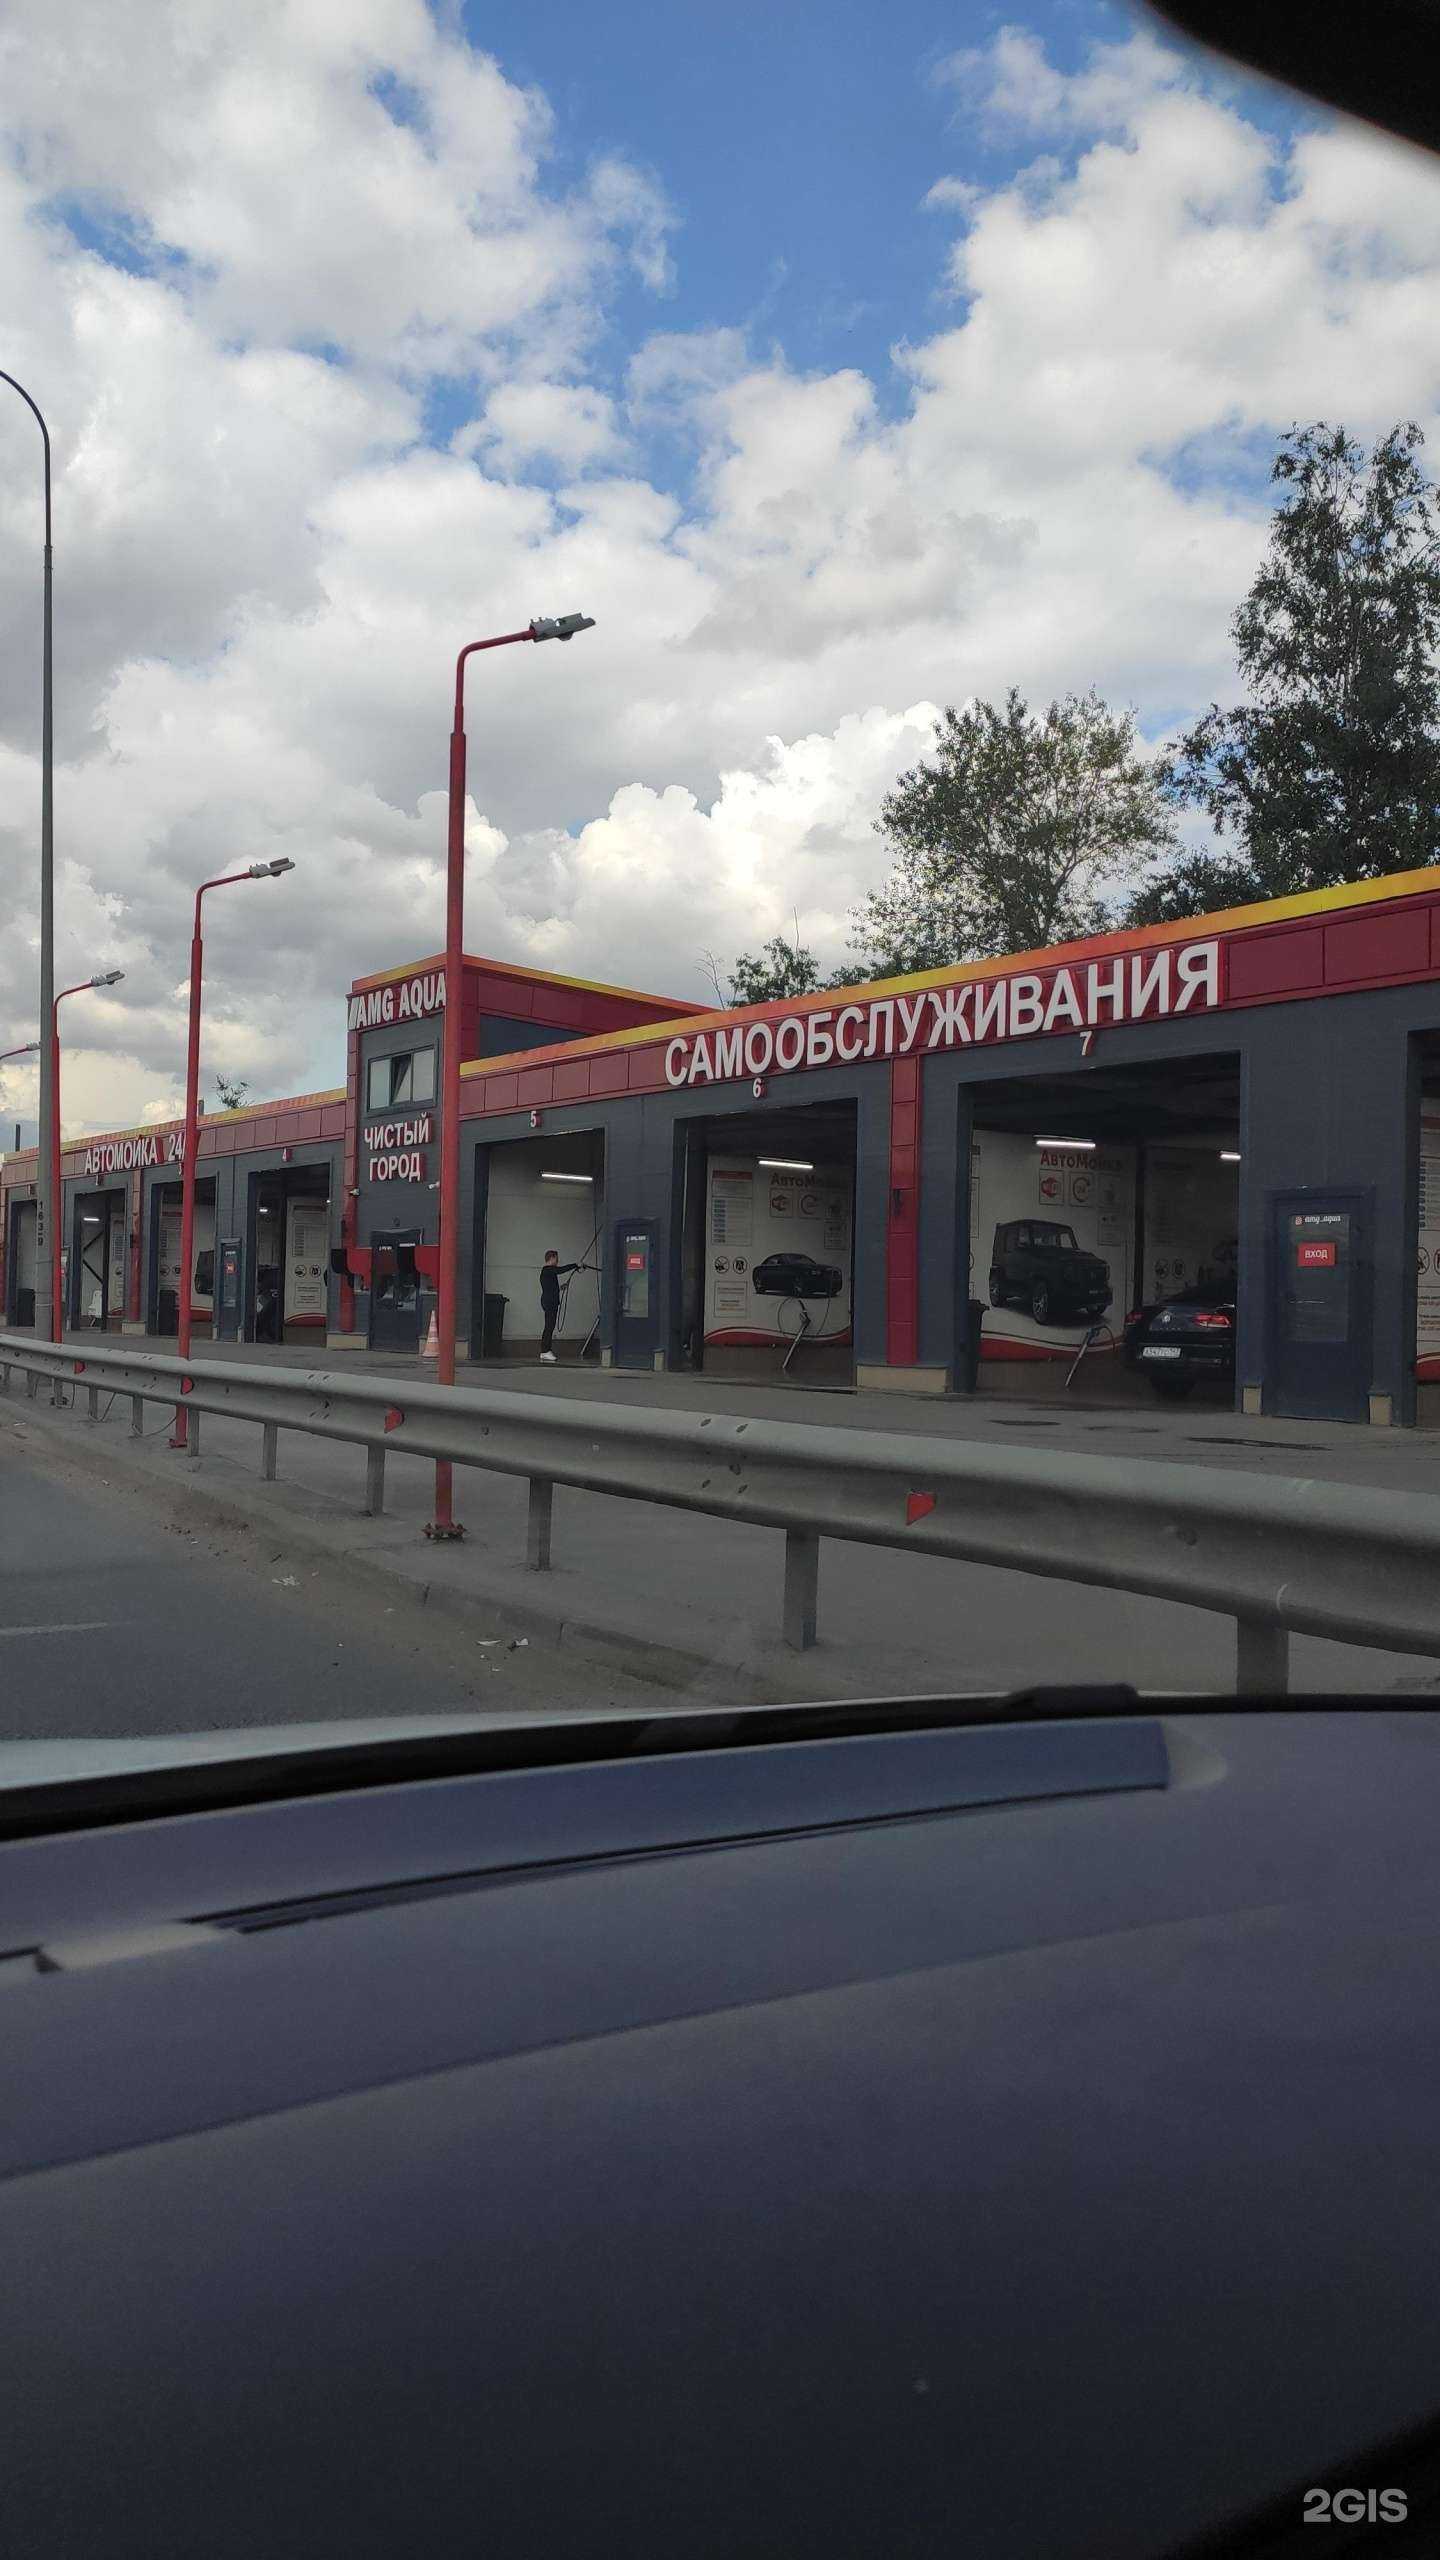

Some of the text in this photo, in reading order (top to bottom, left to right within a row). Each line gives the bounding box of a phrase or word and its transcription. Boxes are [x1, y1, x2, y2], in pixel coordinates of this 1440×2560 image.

[399, 972, 446, 1018] AQUA
[663, 940, 1220, 1086] САМООБСЛУЖИВАНИЯ
[1079, 1031, 1091, 1056] 7
[752, 1077, 762, 1098] 6
[364, 1111, 429, 1150] ЧИСТЫЙ
[529, 1110, 537, 1128] 5
[369, 1152, 421, 1182] ГОРОД
[1304, 1249, 1328, 1260] ВХОД
